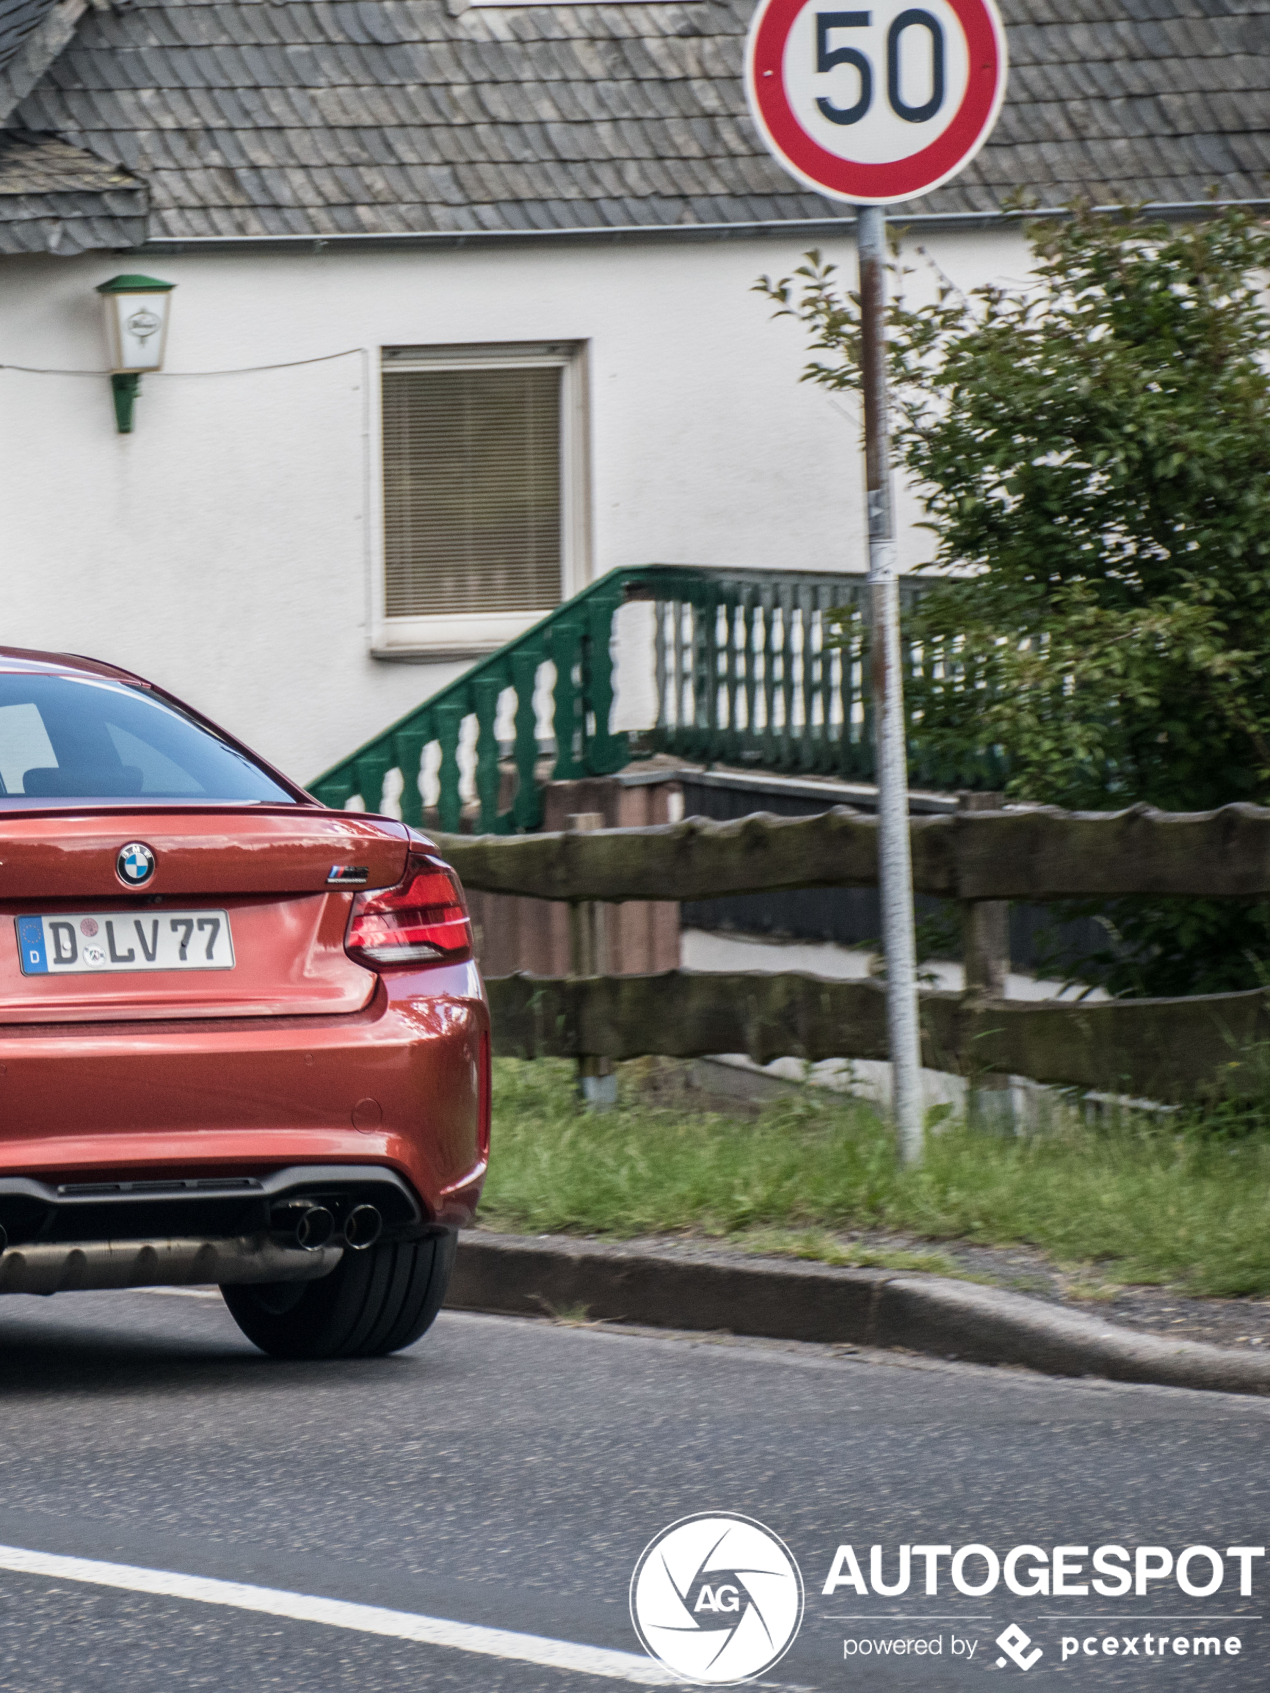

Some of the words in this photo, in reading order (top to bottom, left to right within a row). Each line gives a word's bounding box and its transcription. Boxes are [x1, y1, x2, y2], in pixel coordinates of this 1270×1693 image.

[816, 8, 945, 126] 50
[121, 845, 153, 859] BMW
[30, 950, 40, 964] D
[48, 921, 78, 965] D
[105, 919, 160, 963] LV
[170, 918, 221, 961] 77
